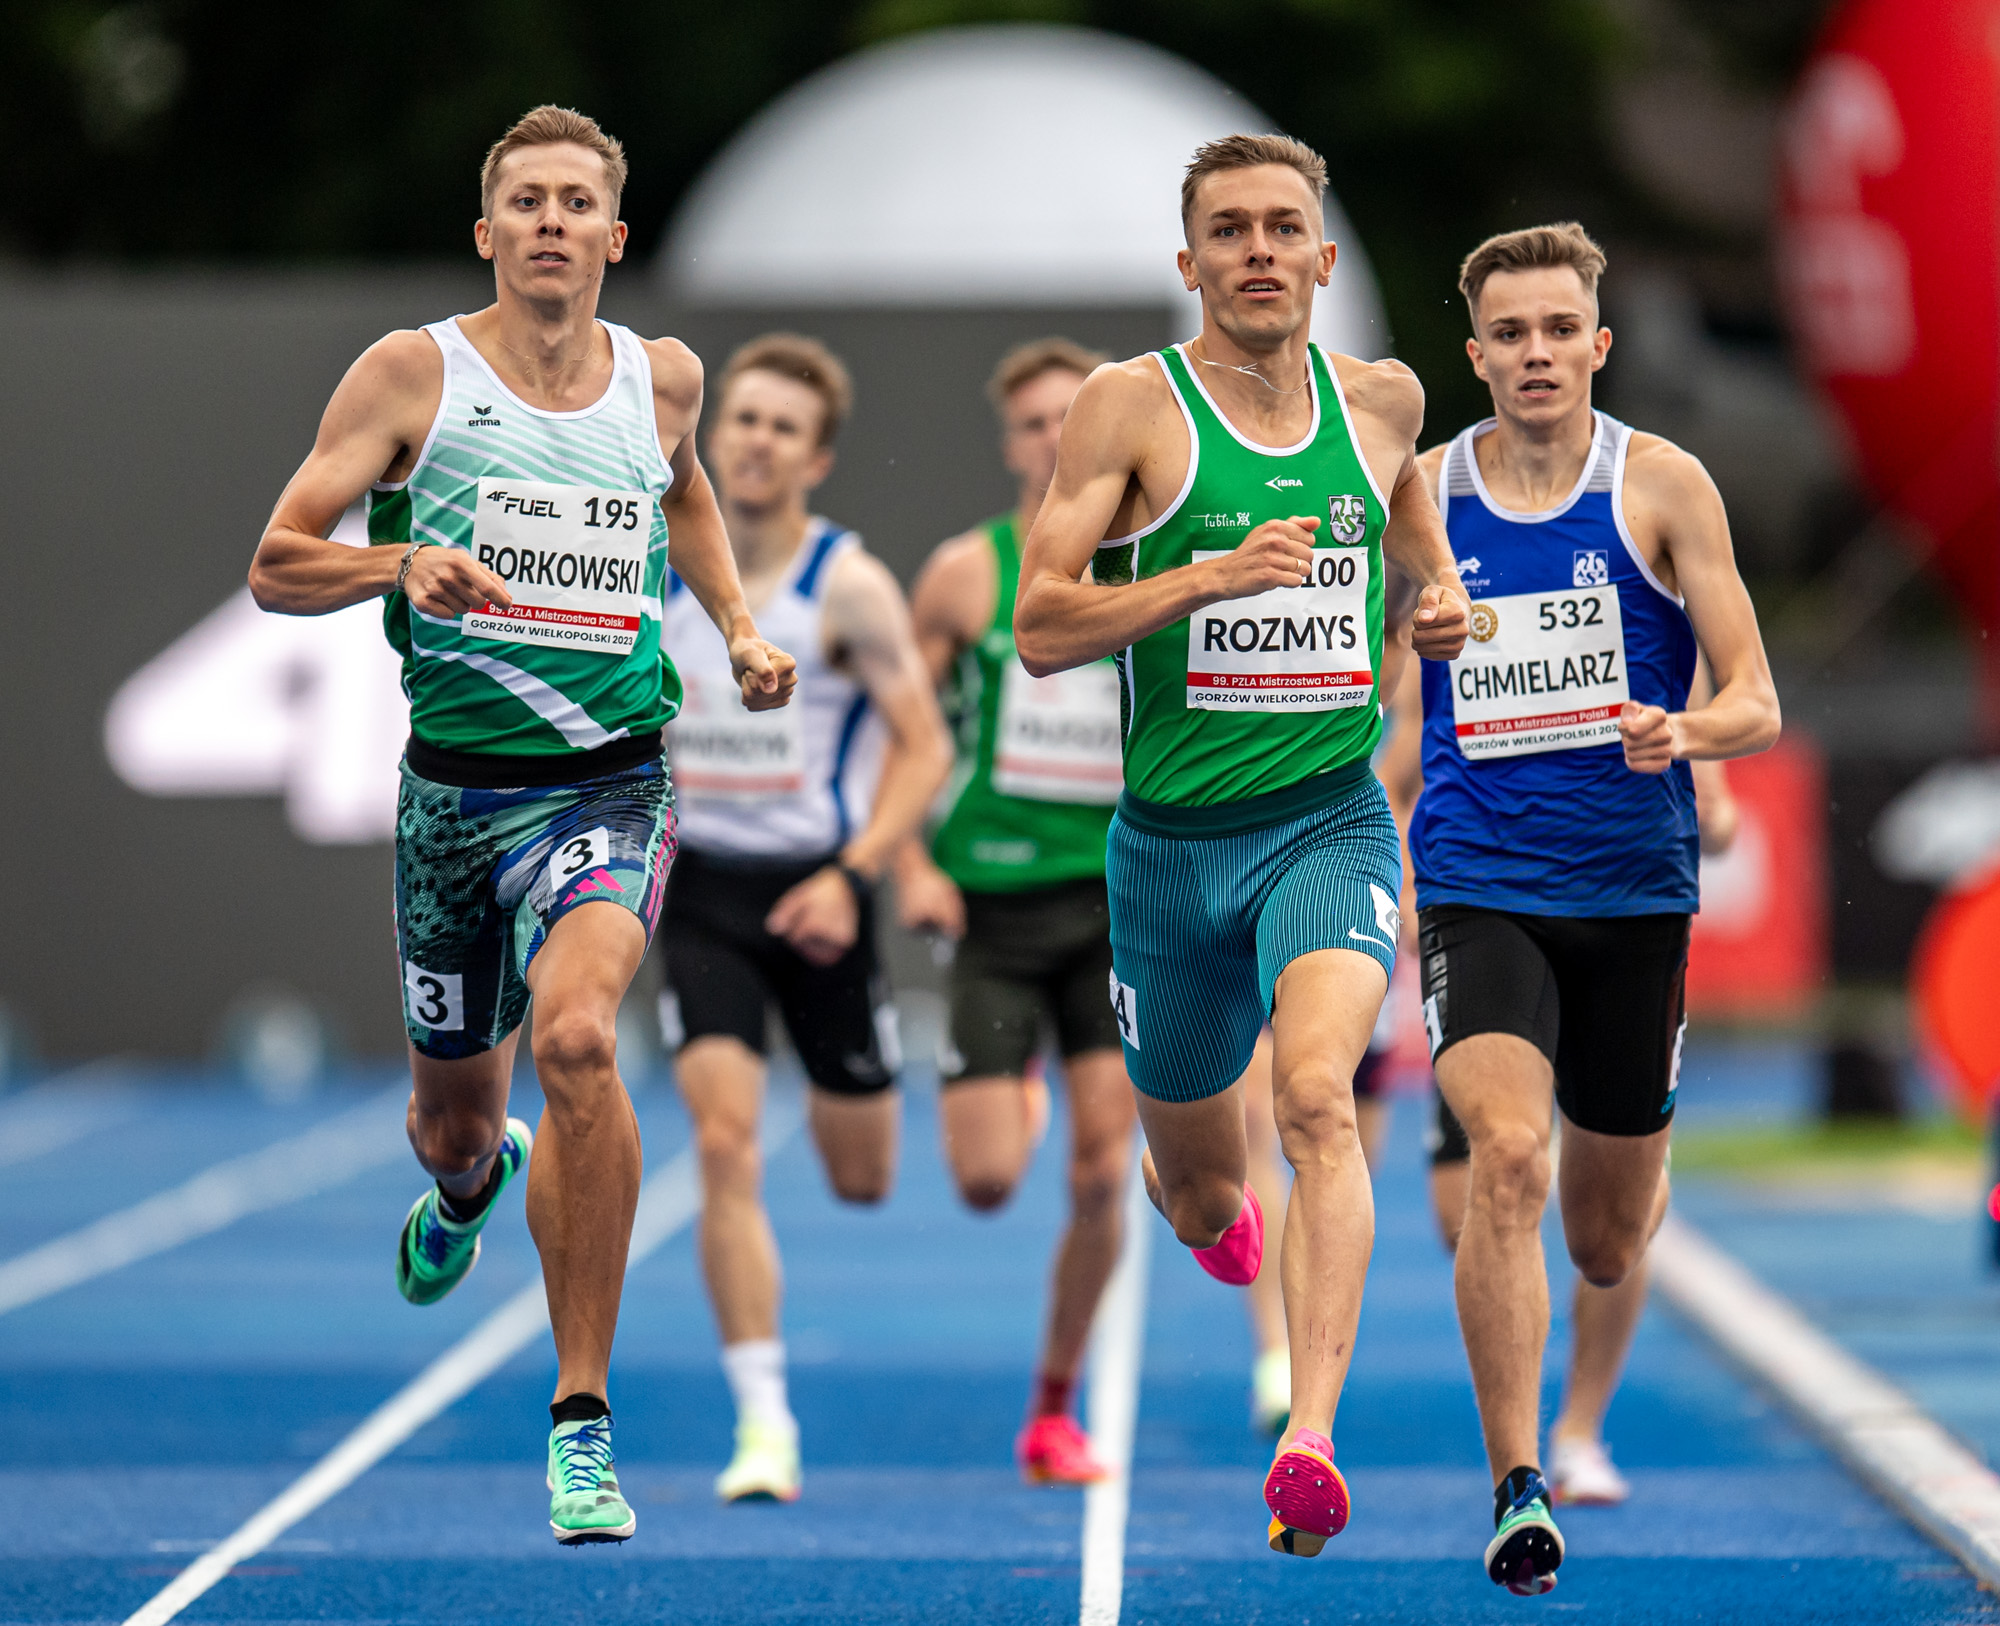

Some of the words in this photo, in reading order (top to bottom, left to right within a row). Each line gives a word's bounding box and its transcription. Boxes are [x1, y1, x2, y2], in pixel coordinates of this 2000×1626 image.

[468, 417, 501, 427] erima
[504, 497, 562, 519] FUEL
[584, 496, 639, 531] 195
[477, 543, 640, 595] BORKOWSKI
[1301, 556, 1356, 588] 100
[507, 606, 533, 618] PZLA
[534, 608, 597, 626] Mistrzostwa
[598, 616, 625, 628] Polski
[1539, 596, 1604, 631] 532
[470, 619, 527, 635] GORZÓW
[528, 626, 610, 644] WIELKOPOLSKI
[612, 635, 633, 646] 2023
[1203, 615, 1357, 652] ROZMYS
[1212, 675, 1229, 686] 99.
[1231, 676, 1257, 687] PZLA
[1259, 676, 1322, 687] Mistrzostwa
[1324, 674, 1352, 685] Polski
[1458, 649, 1619, 701] CHMIELARZ
[1195, 692, 1251, 704] GORZÓW
[1254, 692, 1337, 704] WIELKOPOLSKI
[1339, 690, 1364, 701] 2023
[1463, 737, 1509, 751] GORZÓW
[1512, 728, 1597, 746] WIELKOPOLSKI
[1599, 723, 1618, 735] 202
[1473, 724, 1488, 735] 99.
[1489, 721, 1514, 733] PZLA
[1514, 713, 1577, 730] Mistrzostwa
[1579, 707, 1610, 722] Polski
[562, 837, 594, 875] 3
[416, 975, 449, 1025] 3
[1114, 985, 1132, 1039] 4
